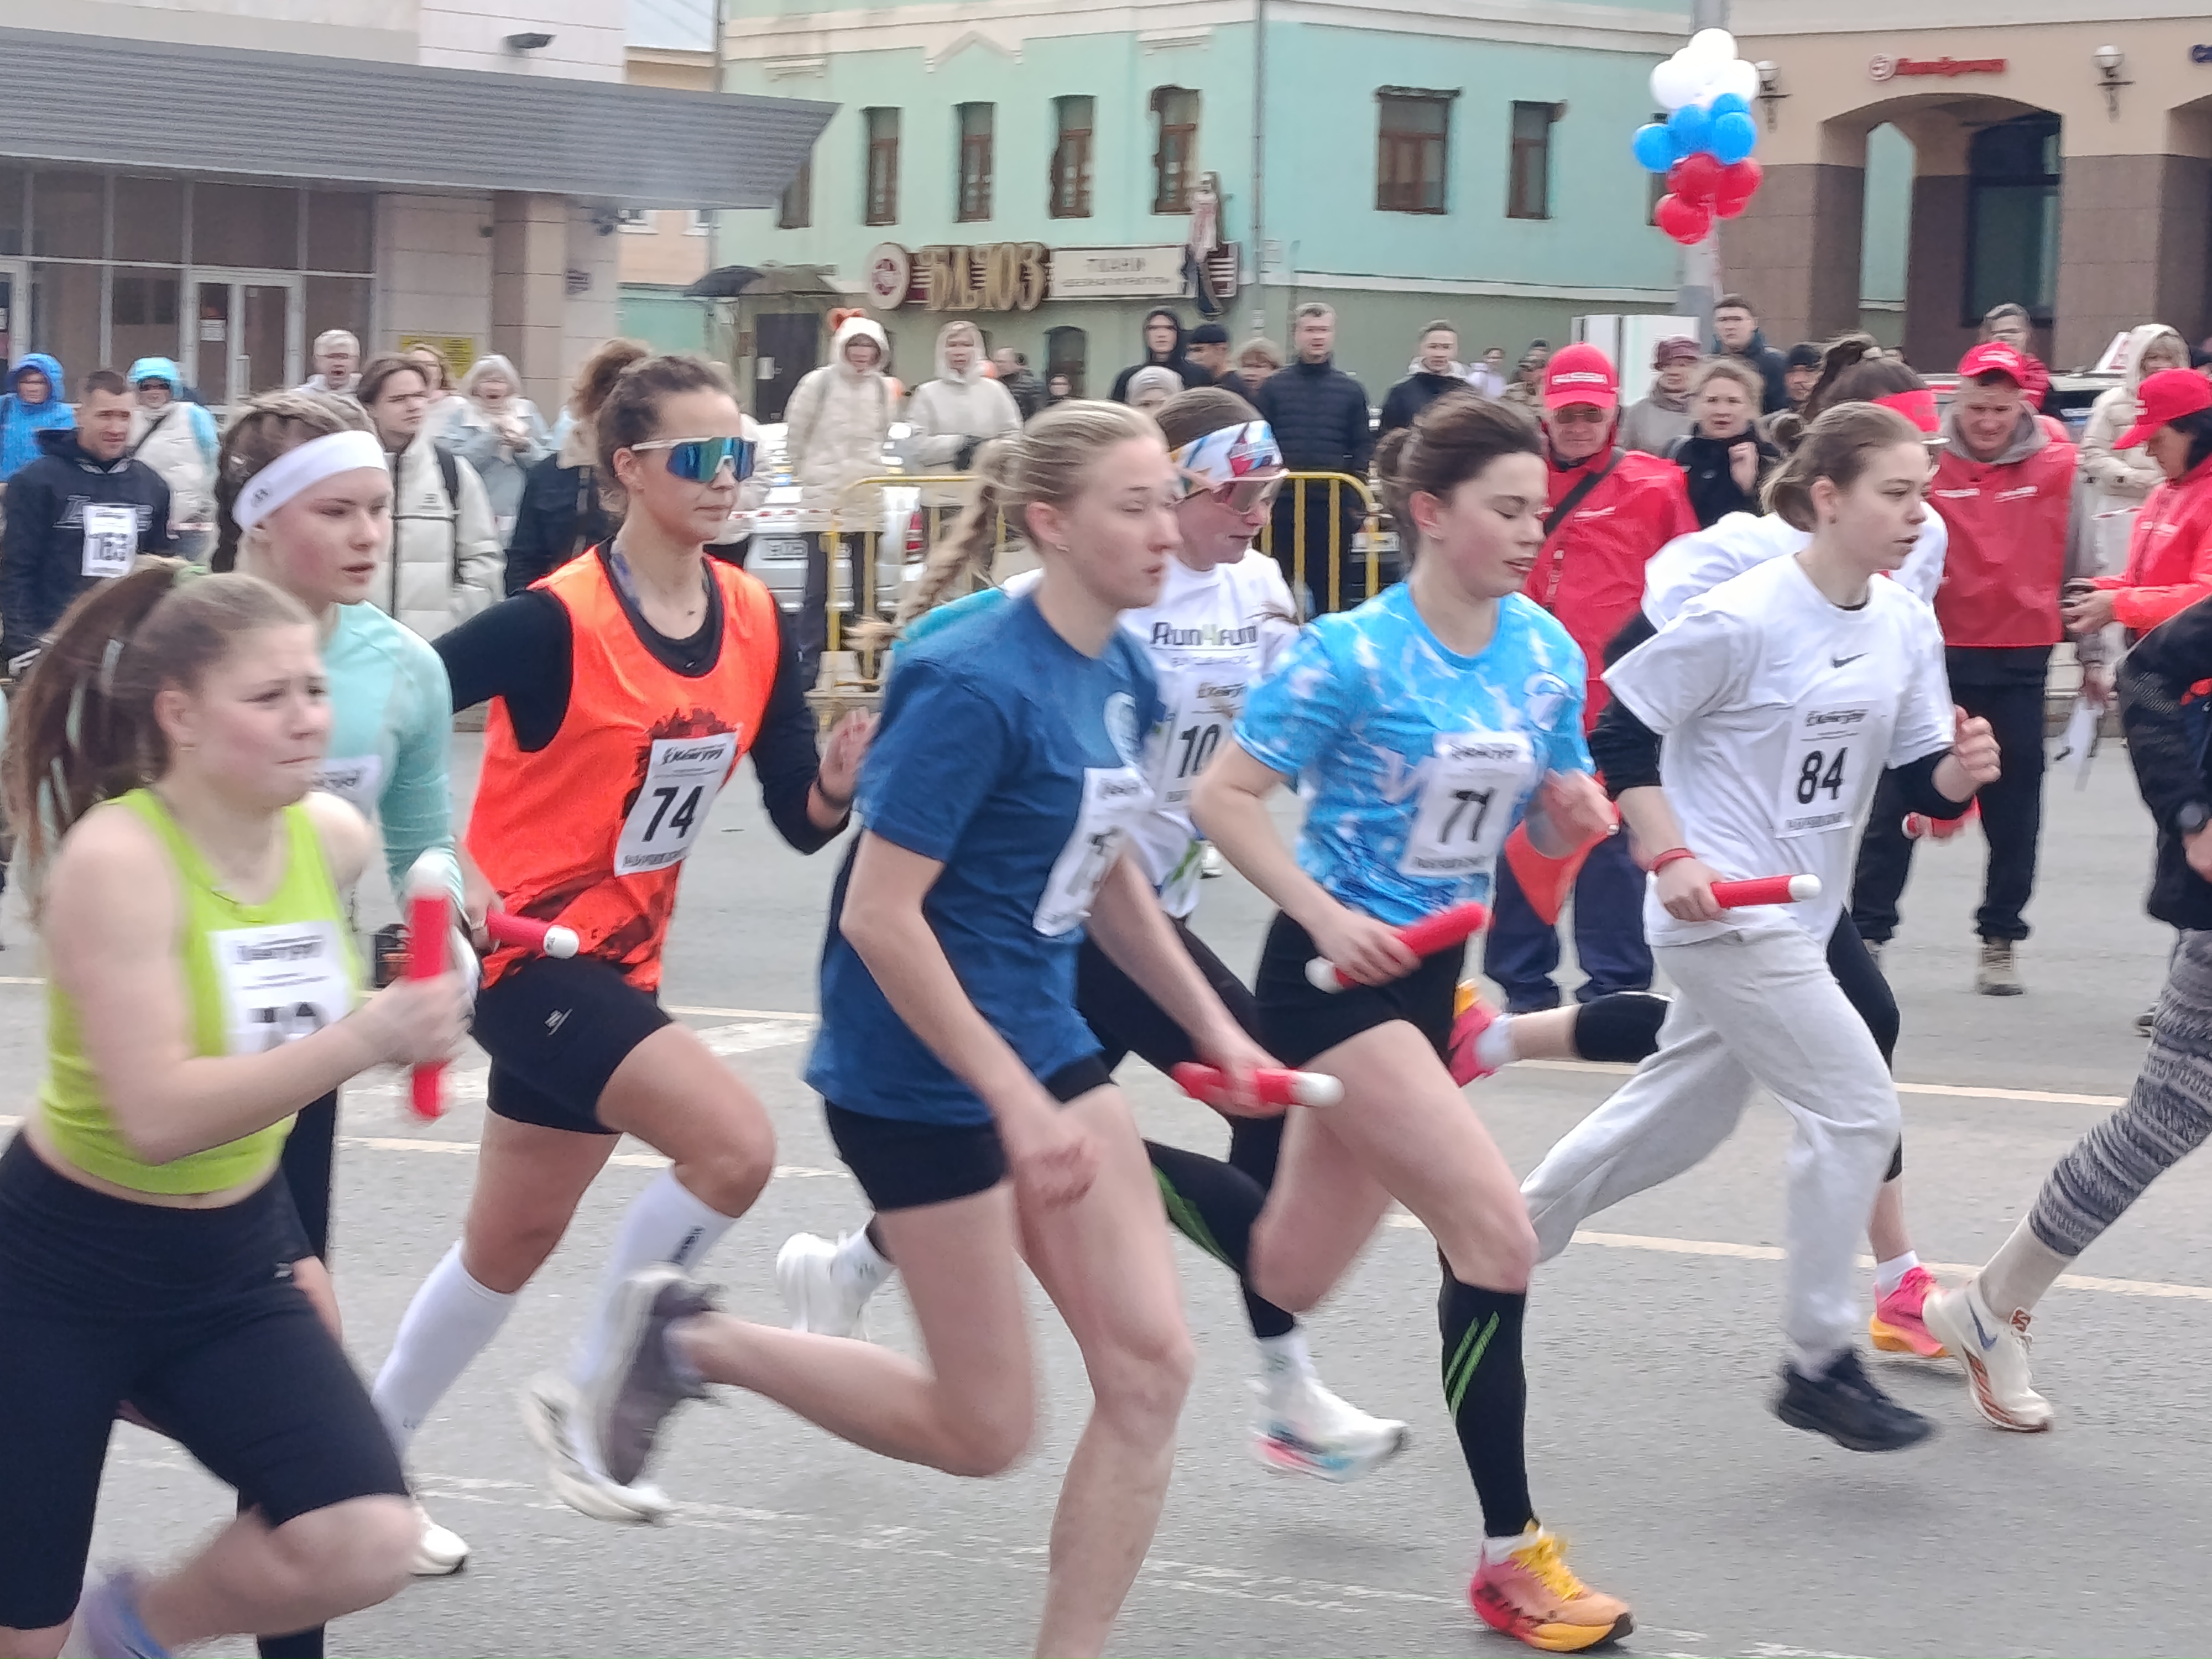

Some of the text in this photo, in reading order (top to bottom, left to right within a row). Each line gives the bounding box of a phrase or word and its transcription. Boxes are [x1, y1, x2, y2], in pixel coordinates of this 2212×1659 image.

[1797, 747, 1848, 804] 84
[641, 785, 705, 842] 74
[1438, 787, 1495, 842] 77
